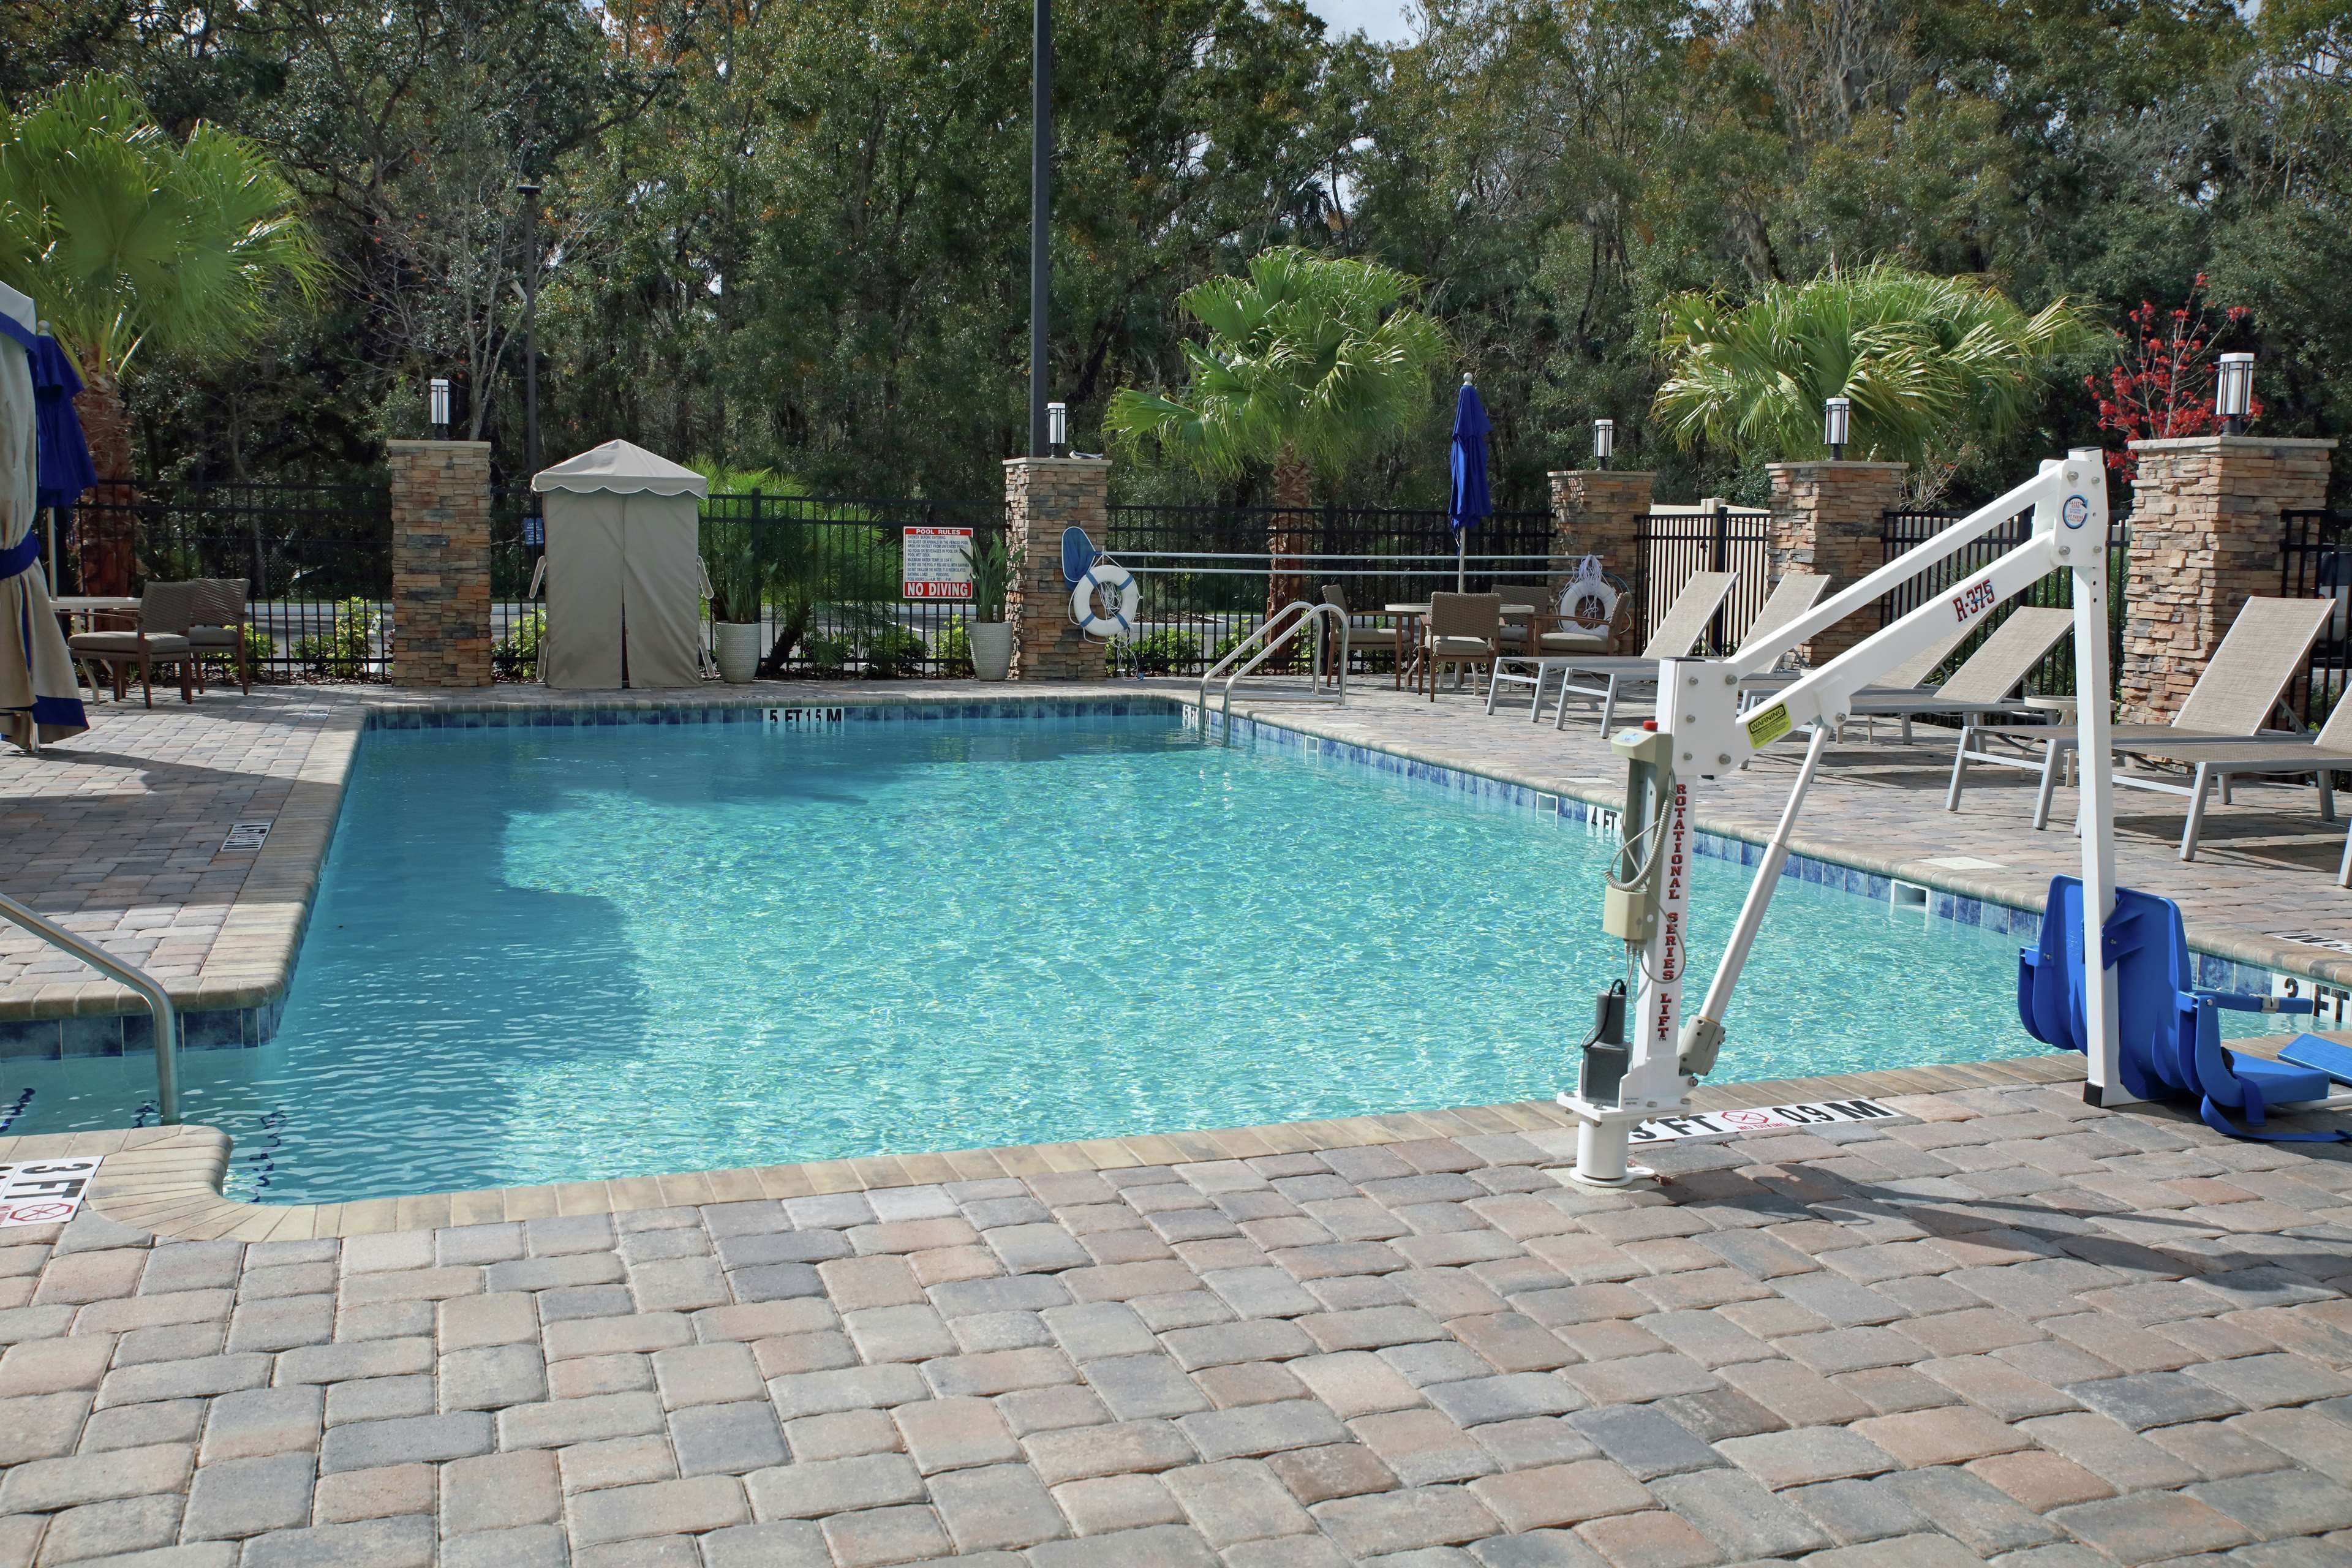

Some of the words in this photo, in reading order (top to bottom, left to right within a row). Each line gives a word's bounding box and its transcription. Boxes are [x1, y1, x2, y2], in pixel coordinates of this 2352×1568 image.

[907, 582, 924, 596] NO
[929, 582, 968, 597] DIVING
[1953, 579, 1996, 622] R-375
[769, 709, 778, 722] 5
[785, 709, 802, 722] FT
[826, 708, 842, 722] M
[1751, 707, 1784, 730] WARNING
[1591, 807, 1598, 826] 4
[1604, 809, 1618, 829] FT
[1668, 783, 1687, 900] ROTATIONAL
[1662, 912, 1679, 980] SERIES
[1657, 993, 1672, 1038] LIFT
[2313, 984, 2351, 1023] FT
[1656, 1115, 1725, 1136] FT
[1772, 1105, 1836, 1123] 0.9
[1822, 1100, 1895, 1120] M
[21, 1163, 94, 1175] 3
[4, 1177, 87, 1199] FT
